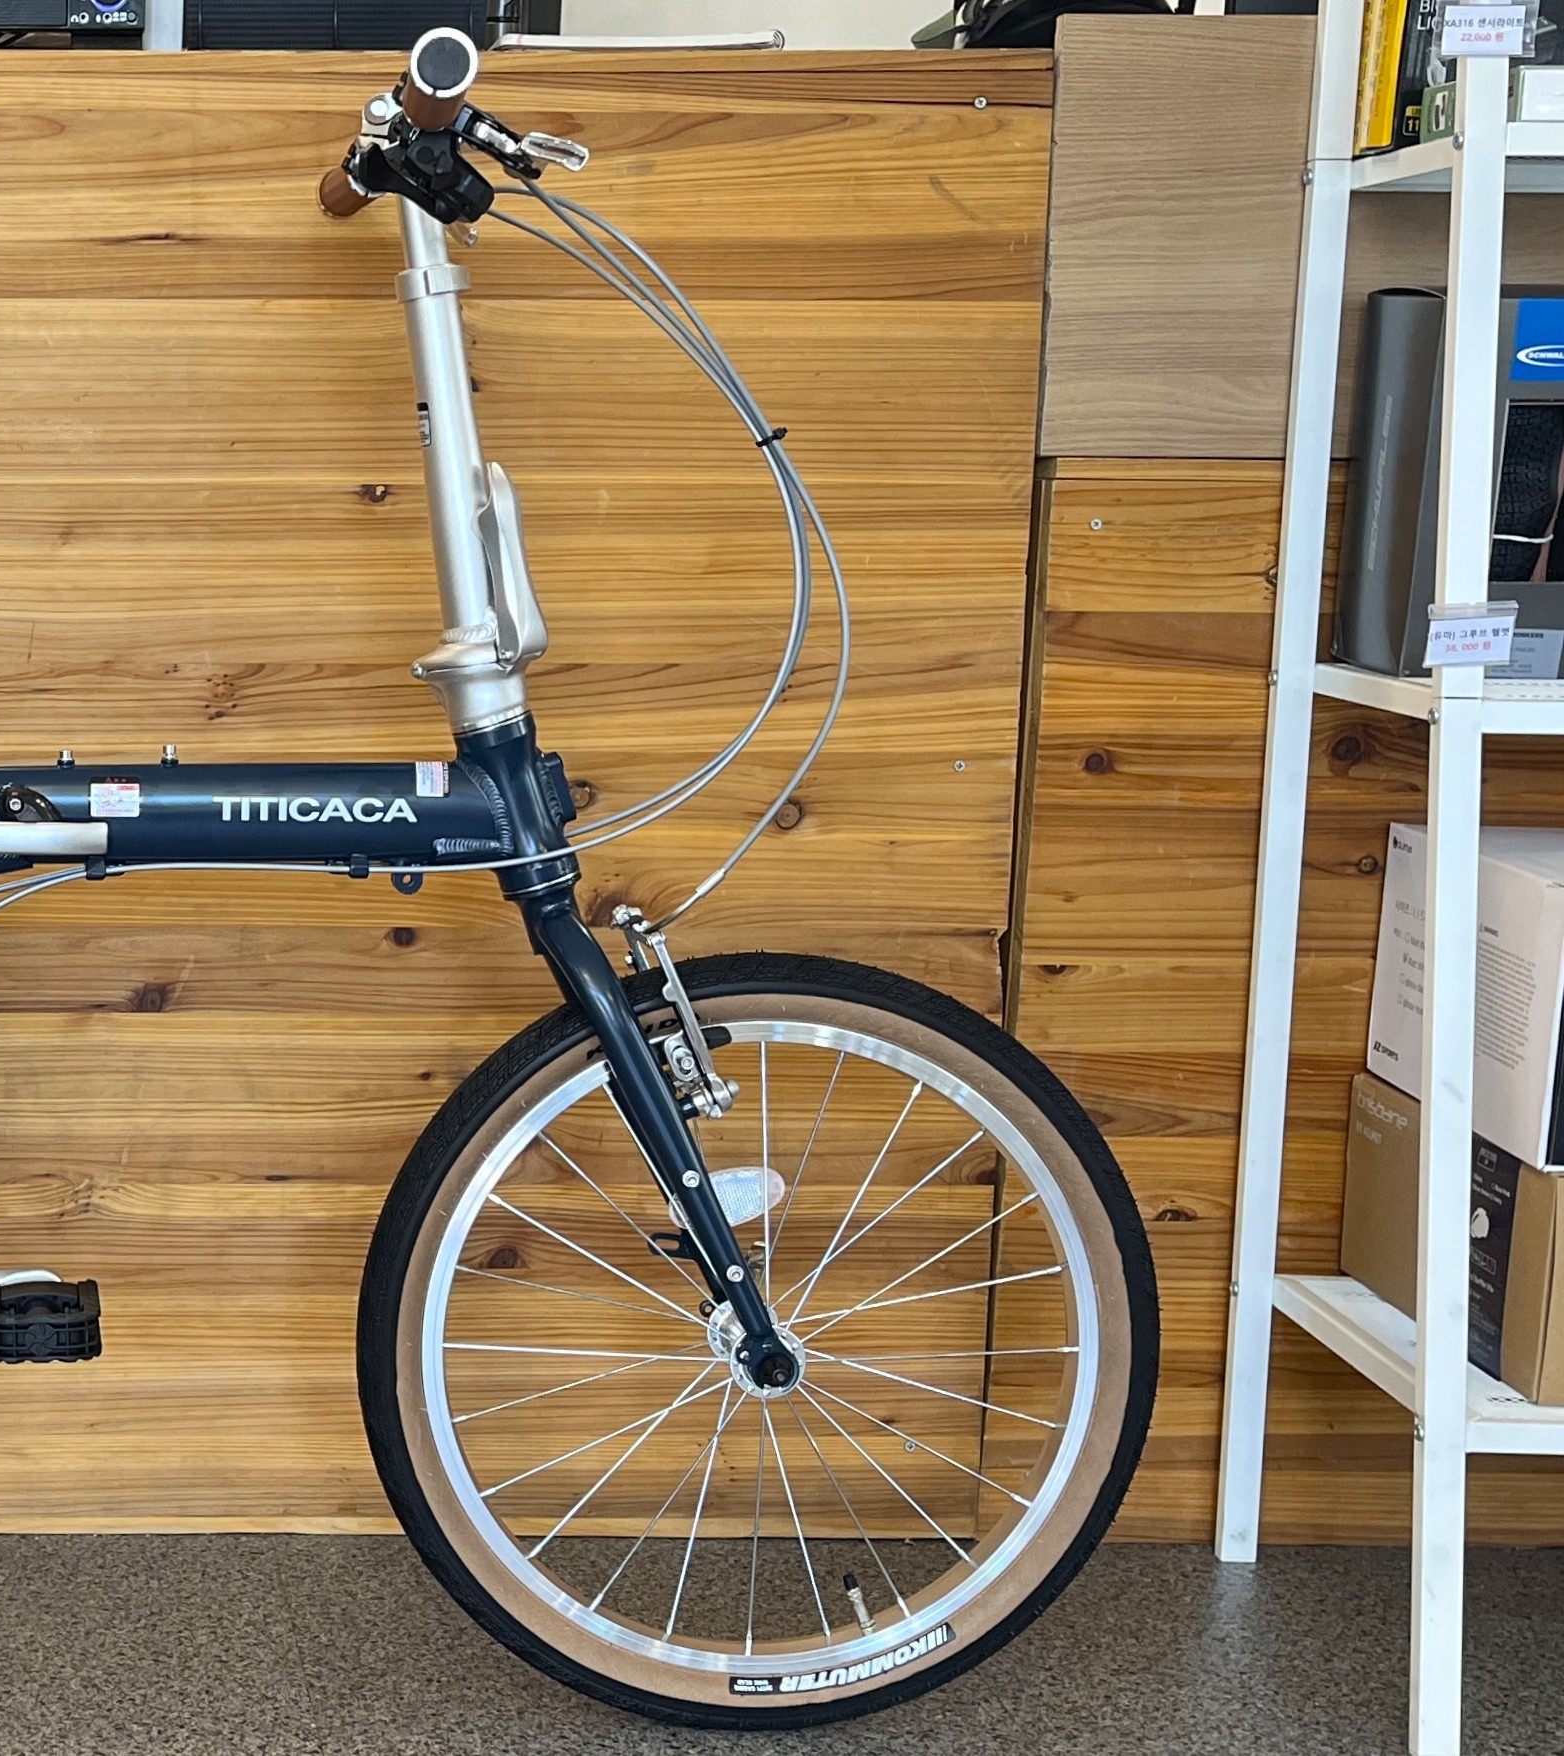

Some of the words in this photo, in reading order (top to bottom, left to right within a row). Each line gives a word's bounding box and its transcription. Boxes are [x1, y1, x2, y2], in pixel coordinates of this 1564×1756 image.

[1460, 32, 1492, 42] 22,000
[1495, 32, 1505, 42] 원
[212, 796, 418, 823] TITICACA
[779, 1636, 927, 1693] KOMMUTER
